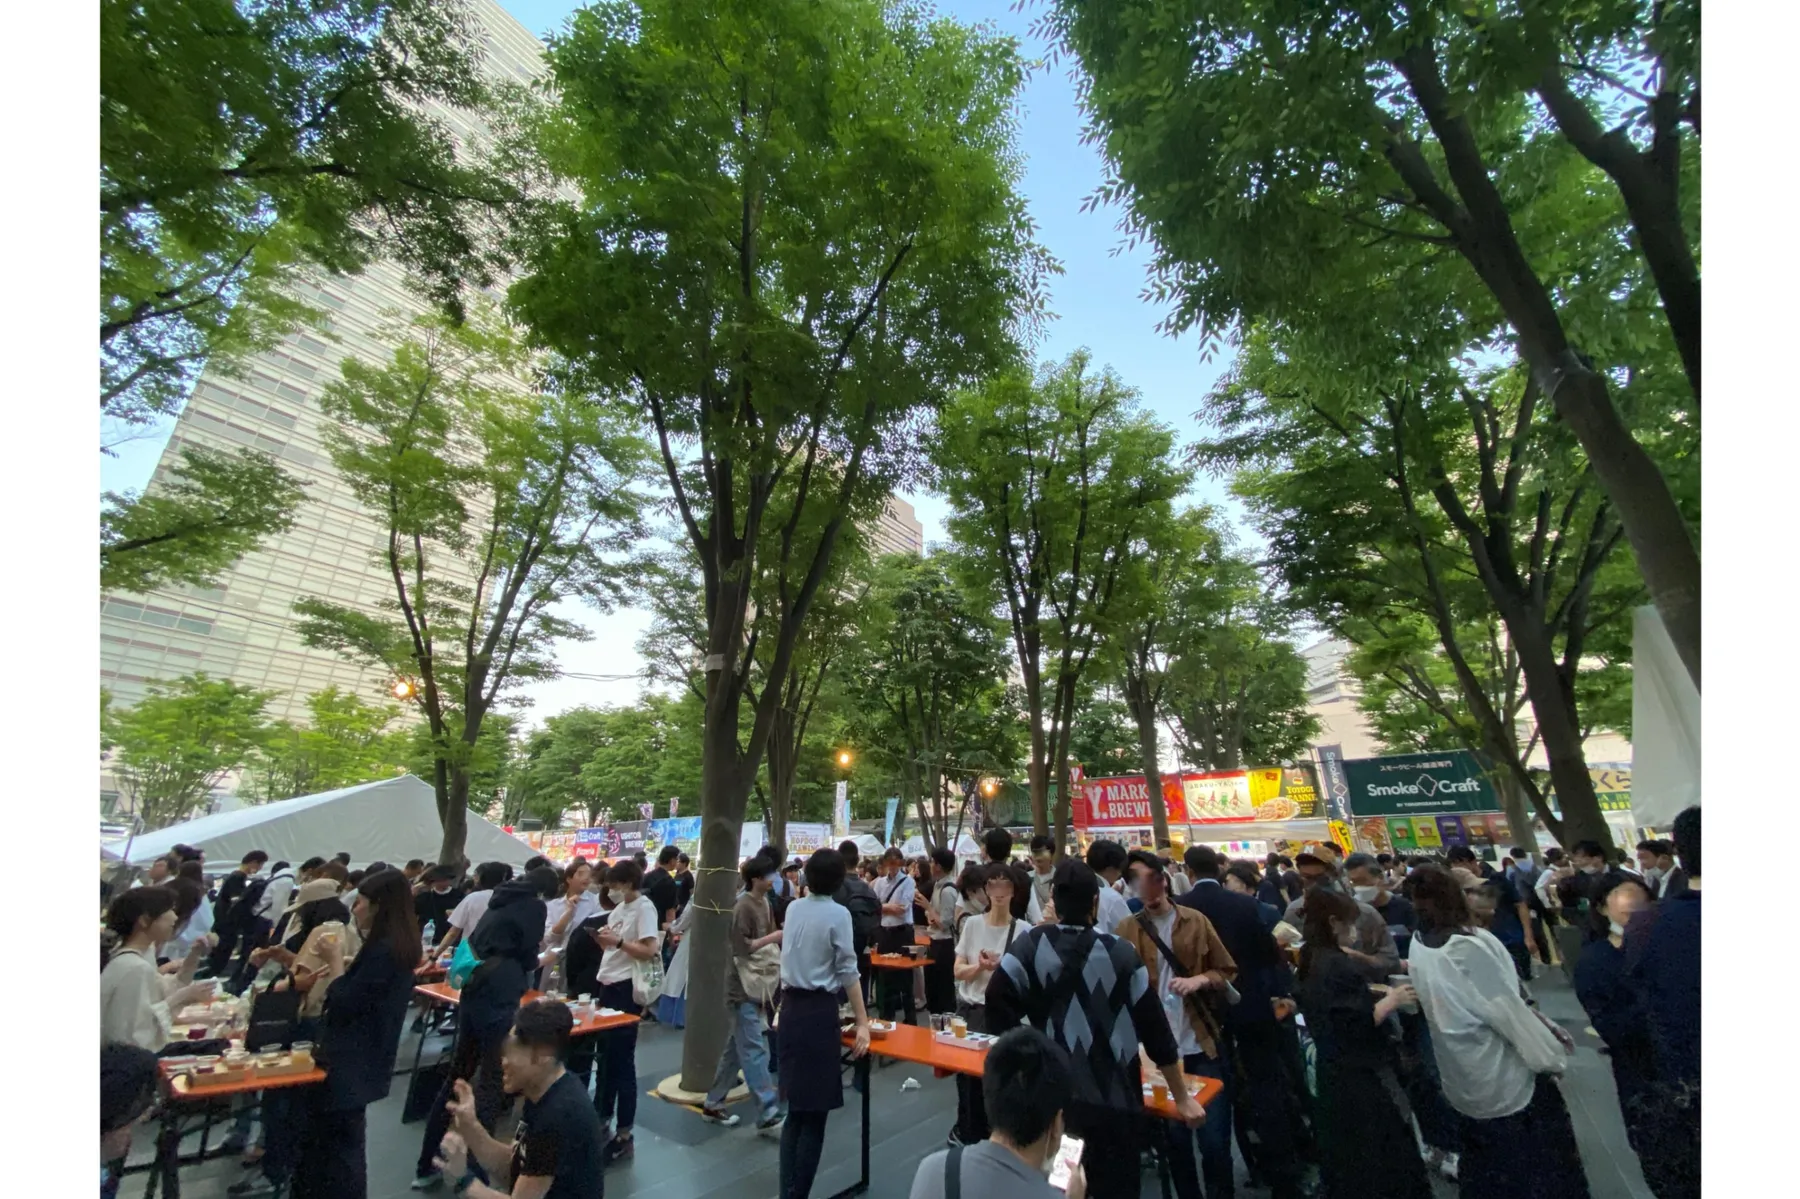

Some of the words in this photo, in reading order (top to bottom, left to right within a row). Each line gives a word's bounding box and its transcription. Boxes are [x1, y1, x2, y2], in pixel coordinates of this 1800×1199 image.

[1326, 752, 1341, 784] Smoke
[1337, 796, 1349, 819] Craft
[1367, 781, 1419, 797] Smoke
[1438, 777, 1481, 793] Craft
[1108, 801, 1170, 818] BREWIG
